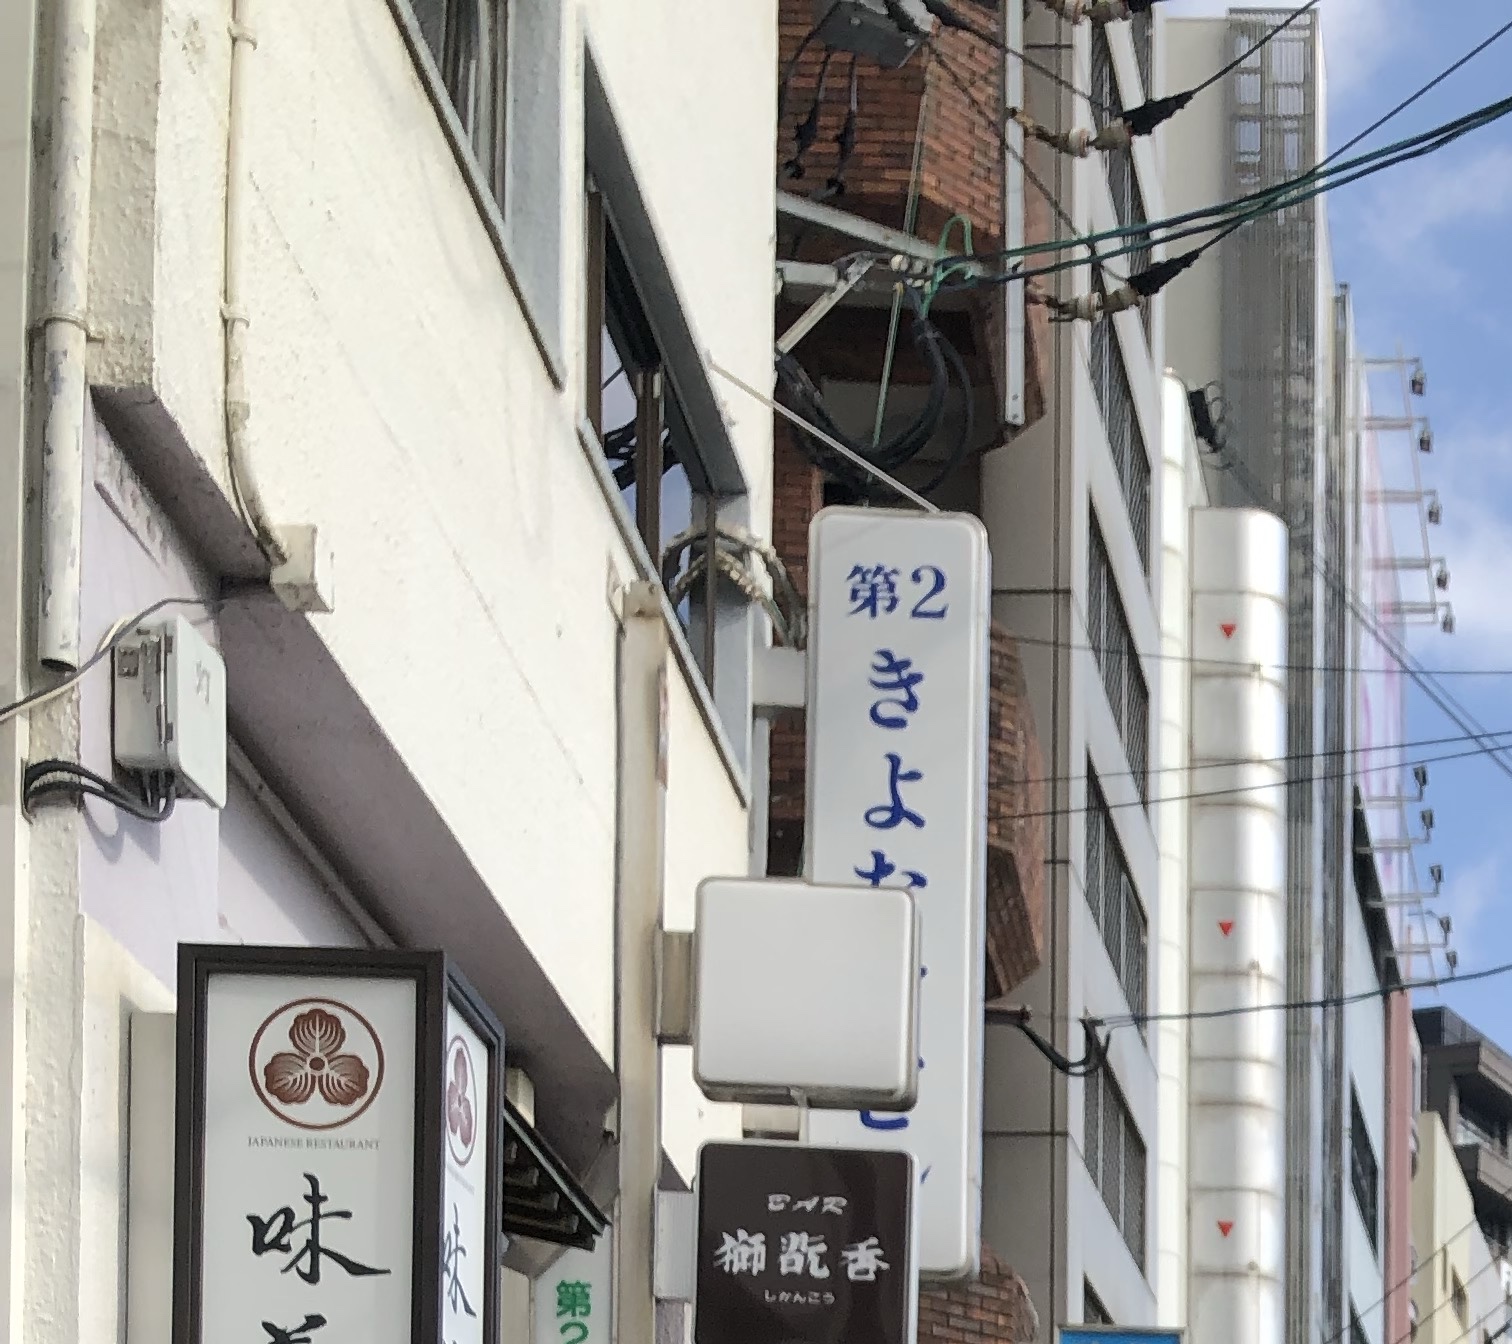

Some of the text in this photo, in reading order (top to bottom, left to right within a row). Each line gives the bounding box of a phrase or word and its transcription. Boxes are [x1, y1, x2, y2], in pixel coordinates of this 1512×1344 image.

[845, 565, 950, 620] 第2
[248, 1136, 380, 1150] JAPANESE RESTAURANT
[767, 1193, 848, 1216] BAR
